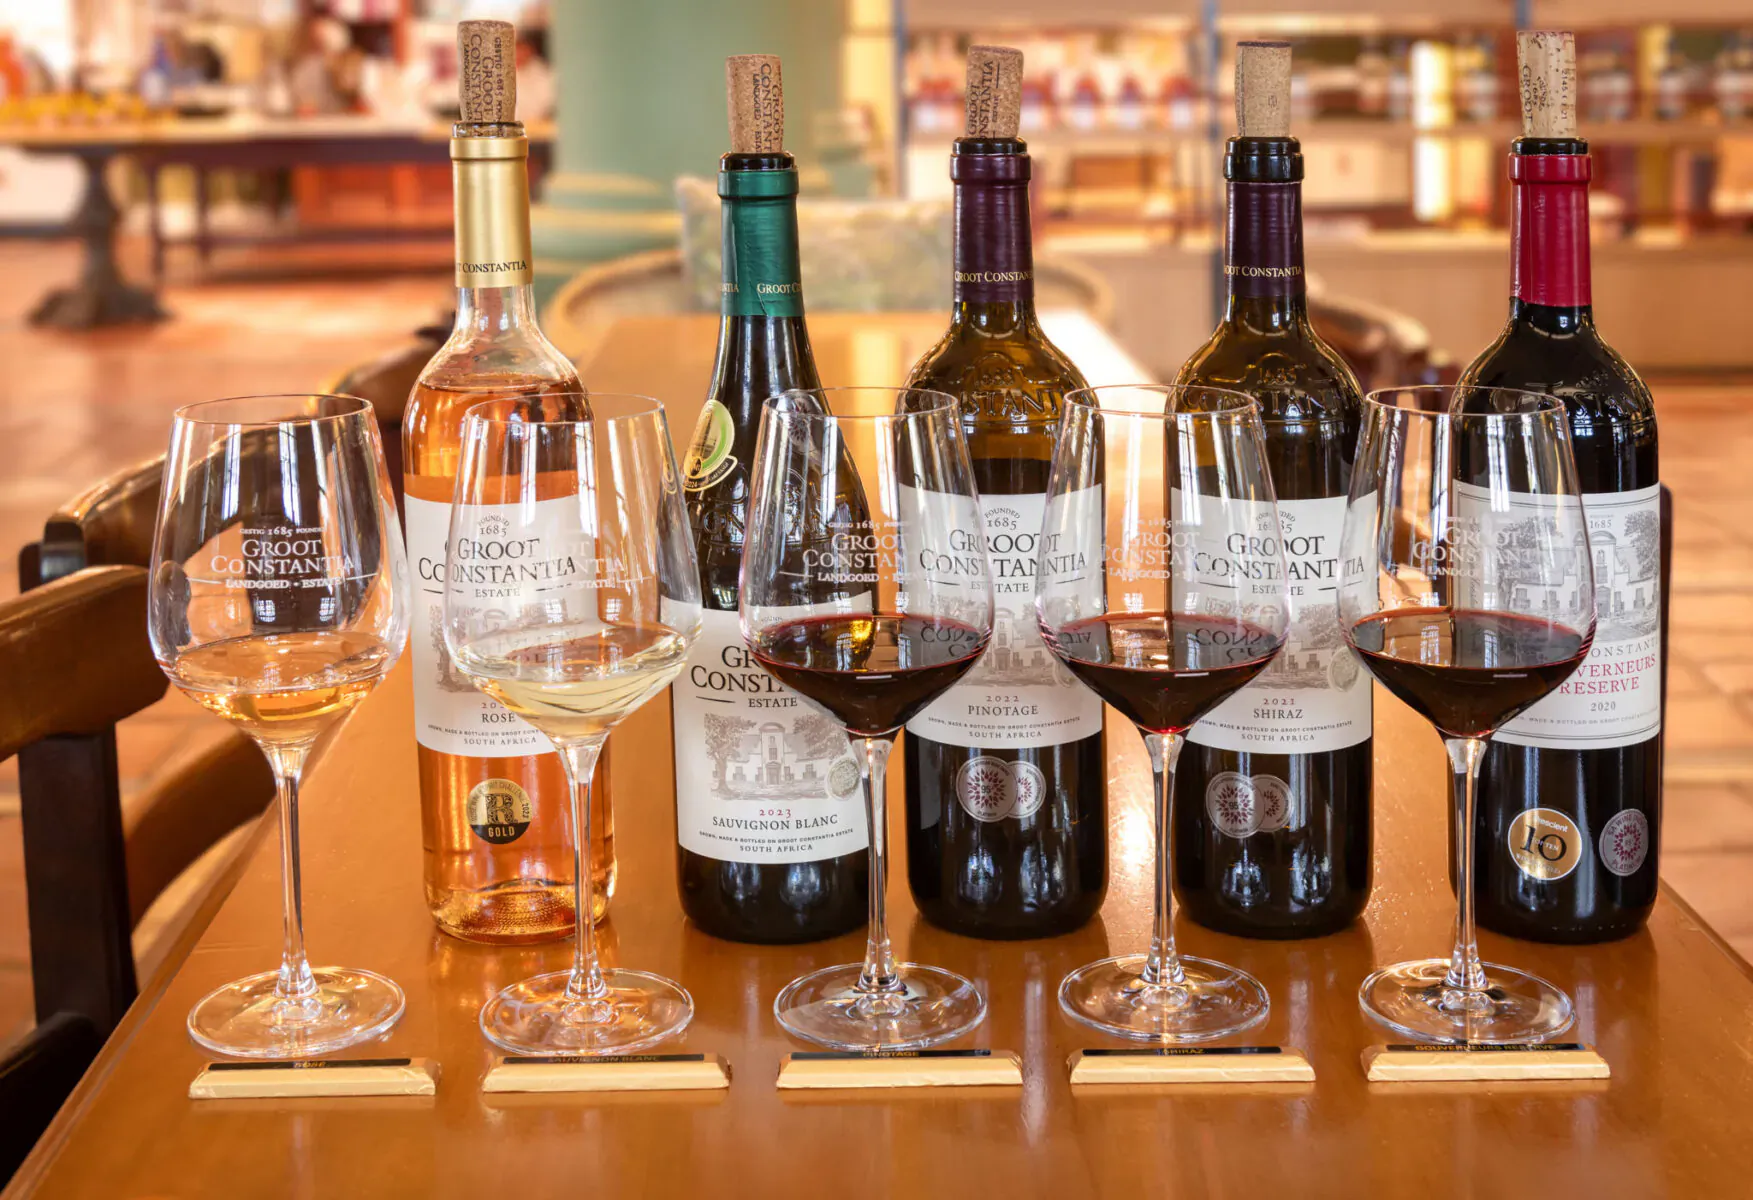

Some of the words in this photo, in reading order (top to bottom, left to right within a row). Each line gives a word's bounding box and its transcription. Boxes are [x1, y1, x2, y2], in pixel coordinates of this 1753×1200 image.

[482, 56, 495, 115] GROOT
[1522, 65, 1533, 122] GROOT
[968, 81, 981, 135] GROOT
[462, 261, 528, 273] CONSTANTIA
[1241, 266, 1303, 277] CONSTANTIA
[757, 282, 791, 294] GROOT
[985, 507, 1021, 519] FOUNDED
[987, 518, 1018, 531] 1685
[1589, 520, 1613, 530] 1685
[267, 526, 293, 538] 1685
[479, 526, 508, 538] 1685
[241, 539, 322, 558] GROOT
[1227, 533, 1326, 558] GROOT
[210, 555, 355, 575] CONSTANTIA
[919, 548, 1087, 579] CONSTANTIA
[225, 579, 290, 589] LANDGOED
[475, 588, 521, 598] ESTATE
[1558, 676, 1641, 695] RESERVE
[748, 697, 798, 708] ESTATE
[986, 695, 1019, 703] 2022
[1263, 698, 1296, 706] 2021
[968, 705, 1039, 717] PINOTAGE
[1590, 700, 1617, 712] 2020
[1253, 708, 1304, 720] SHIRAZ
[969, 730, 1002, 739] SOUTH
[1241, 733, 1275, 741] SOUTH
[1279, 732, 1315, 742] AFRICA
[463, 738, 496, 746] SOUTH
[500, 737, 537, 746] AFRICA
[759, 808, 793, 818] 2023
[712, 816, 791, 831] SAUVIGNON
[795, 814, 839, 829] BLANC
[488, 825, 516, 838] GOLD
[739, 845, 773, 853] SOUTH
[776, 844, 814, 853] AFRICA
[1520, 825, 1567, 862] 10
